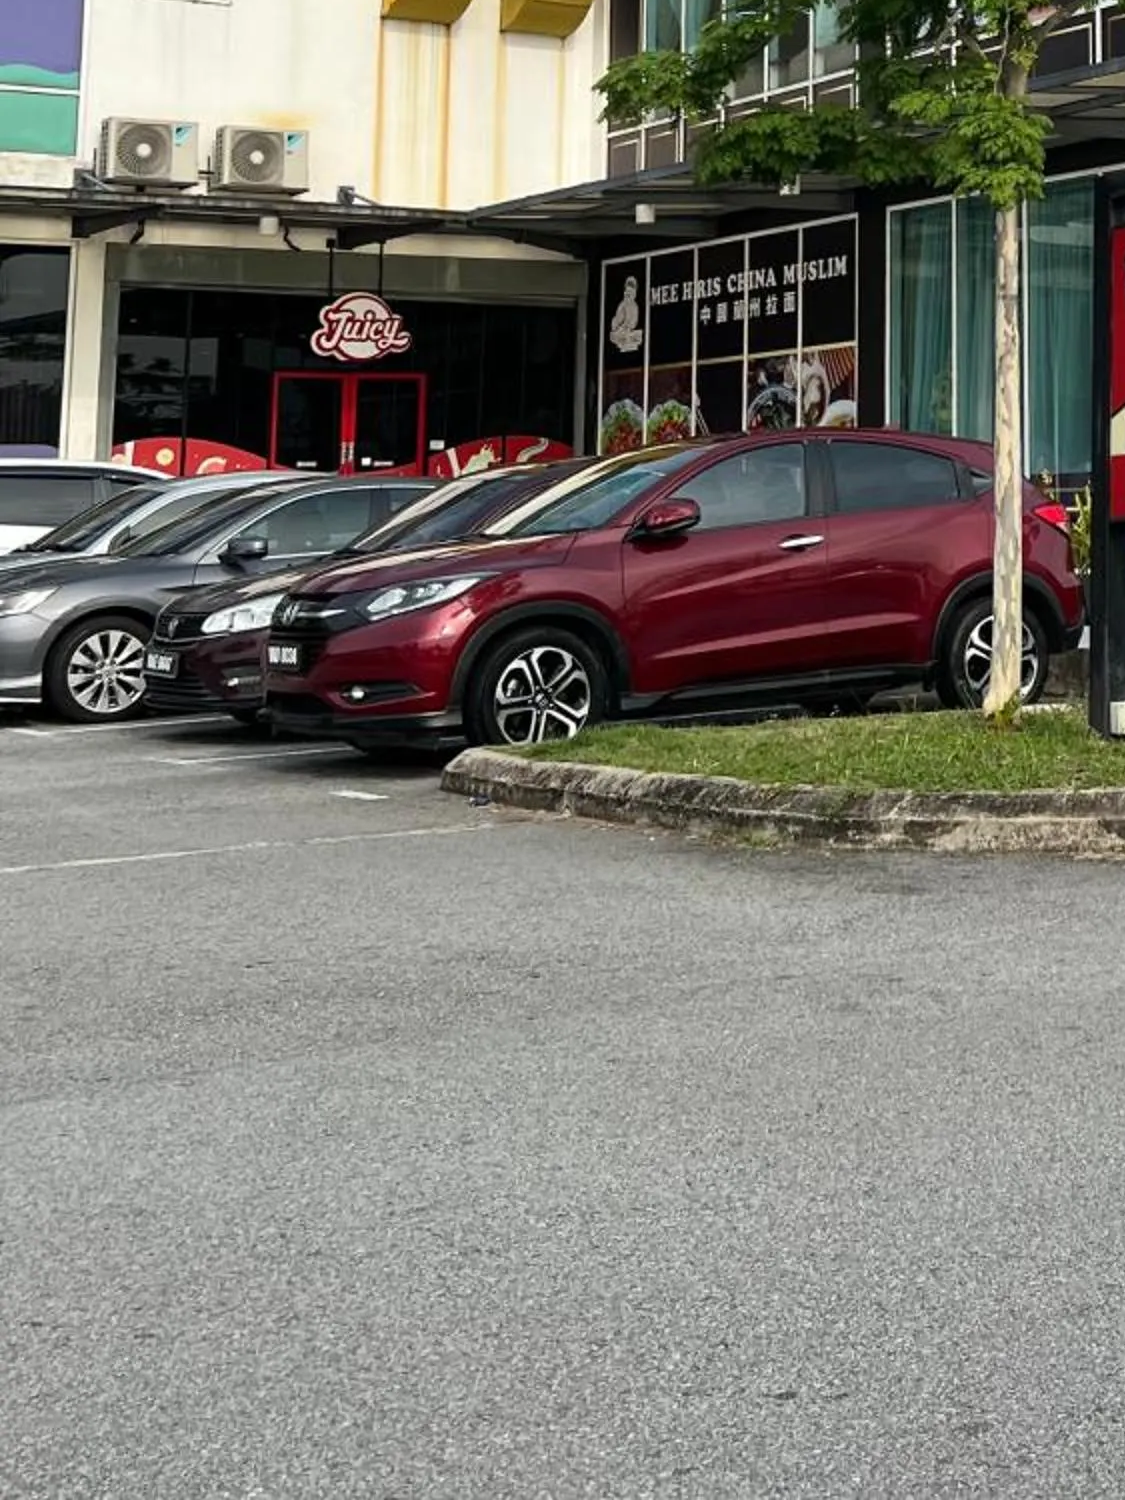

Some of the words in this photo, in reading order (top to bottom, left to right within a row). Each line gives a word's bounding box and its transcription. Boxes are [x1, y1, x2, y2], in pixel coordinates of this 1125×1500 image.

[650, 284, 679, 306] MEE
[683, 277, 722, 300] HIRIS
[727, 267, 776, 293] CHINA
[783, 255, 848, 285] MUSLIM
[319, 308, 410, 350] Juicy
